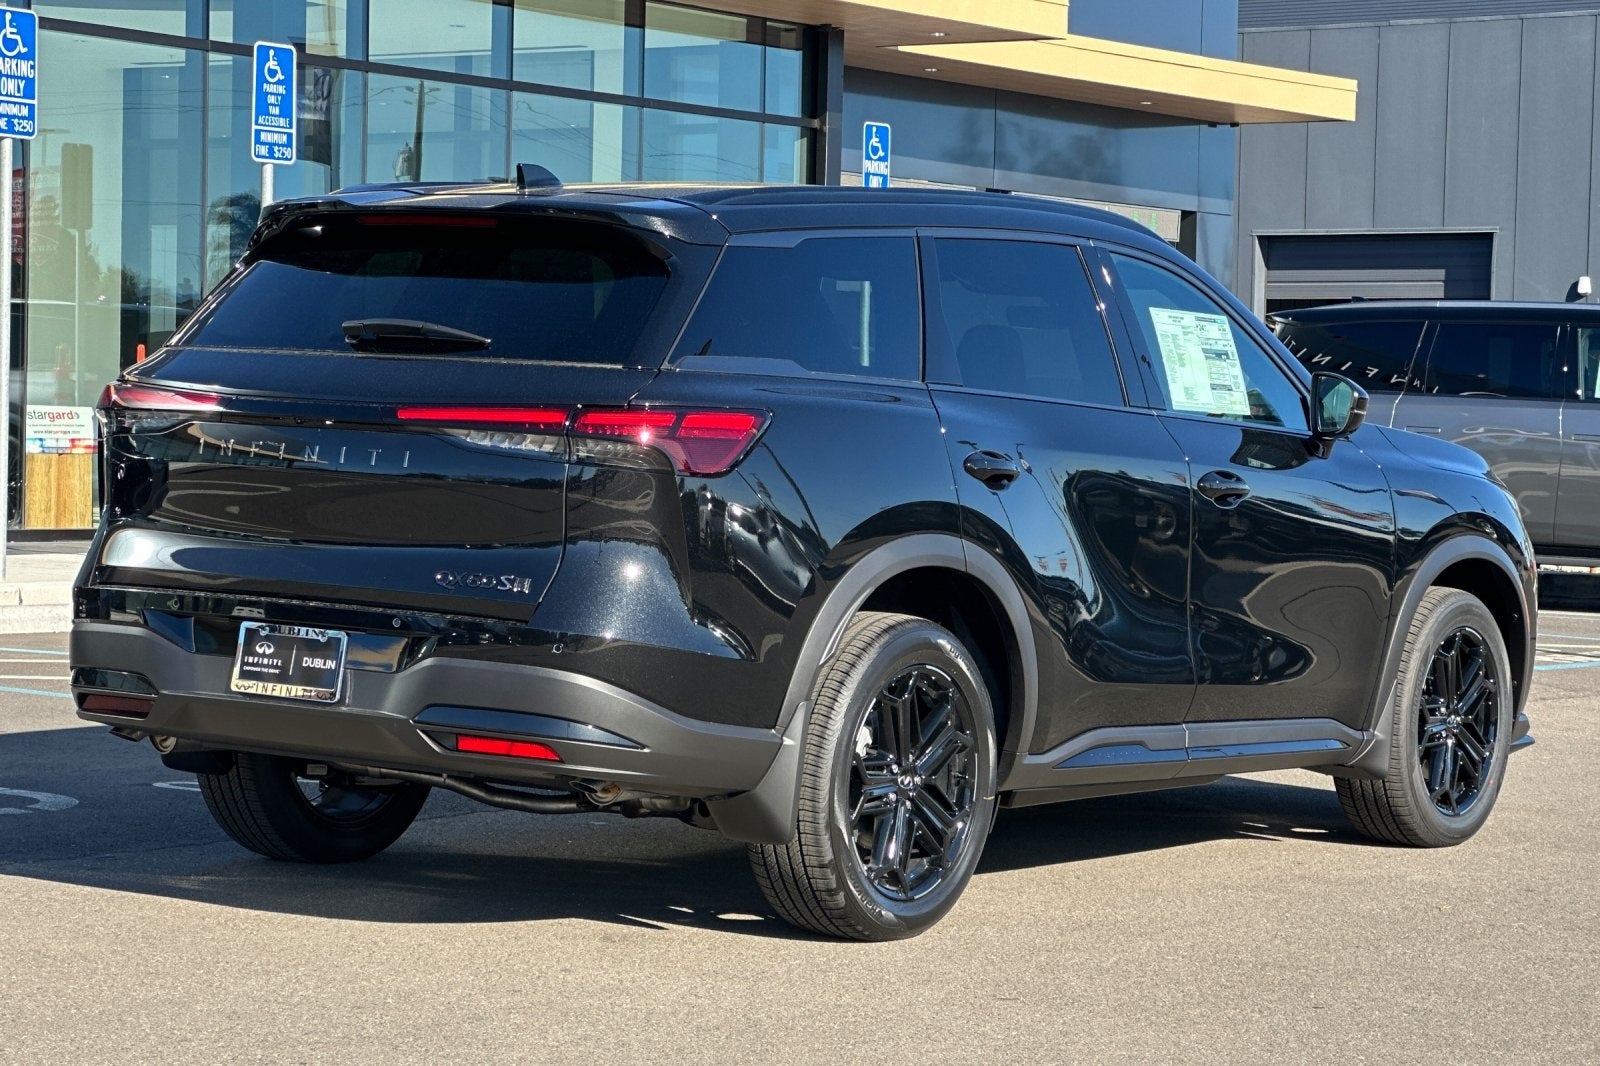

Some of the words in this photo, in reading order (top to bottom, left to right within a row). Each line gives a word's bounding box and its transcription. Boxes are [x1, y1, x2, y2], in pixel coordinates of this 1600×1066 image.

[0, 57, 34, 78] ARKING
[1, 77, 25, 97] ONLY
[263, 83, 286, 95] PARKING
[267, 94, 282, 105] ONLY
[268, 105, 280, 116] VAN
[13, 117, 33, 133] $250
[258, 115, 290, 128] ACCESSIBLE
[260, 131, 287, 145] MINIMUM
[255, 144, 269, 157] FINE
[273, 145, 292, 160] $250
[865, 159, 888, 176] PARKING
[869, 174, 884, 188] ONLY
[27, 410, 74, 422] stargard
[199, 437, 410, 468] INFINITI
[270, 624, 322, 638] UBLIN
[244, 655, 282, 666] INFINITI
[302, 656, 336, 670] DUBLIN
